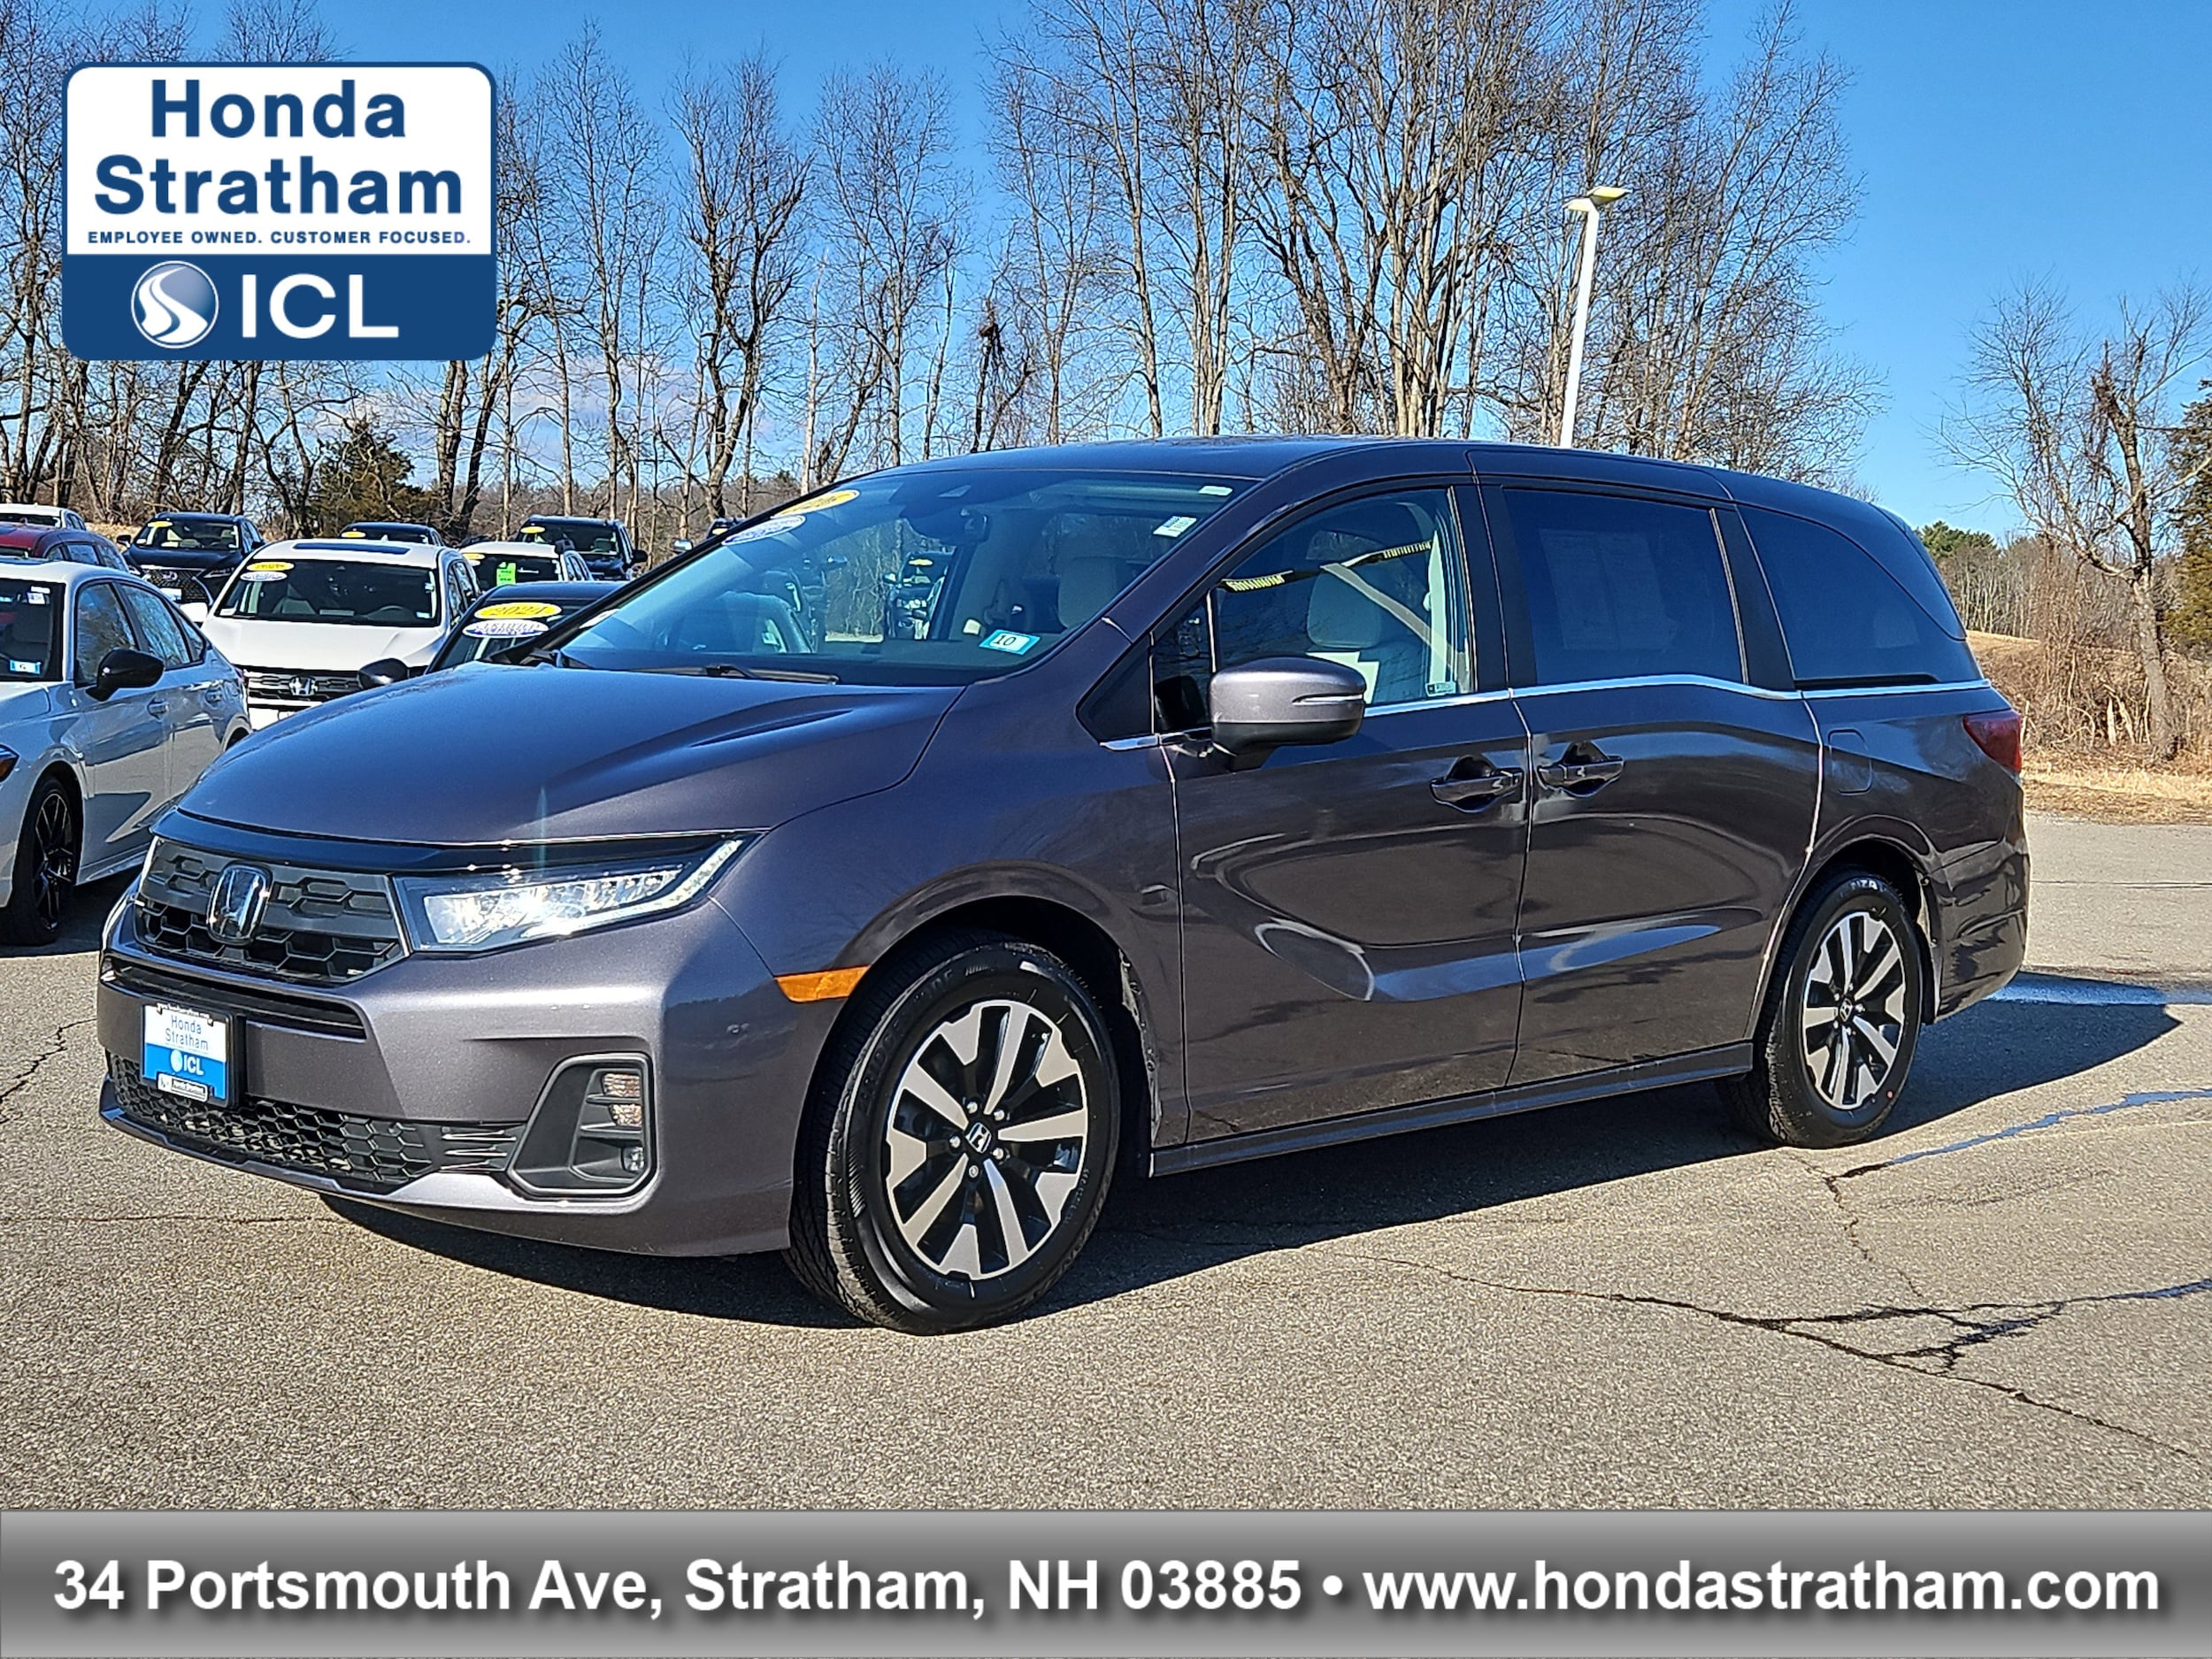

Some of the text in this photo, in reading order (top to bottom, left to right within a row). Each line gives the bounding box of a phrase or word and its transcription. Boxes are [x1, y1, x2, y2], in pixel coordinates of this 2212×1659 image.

[993, 634, 1017, 646] 10
[171, 1015, 202, 1034] Honda
[165, 1027, 209, 1051] Stratham
[183, 1054, 204, 1076] ICL
